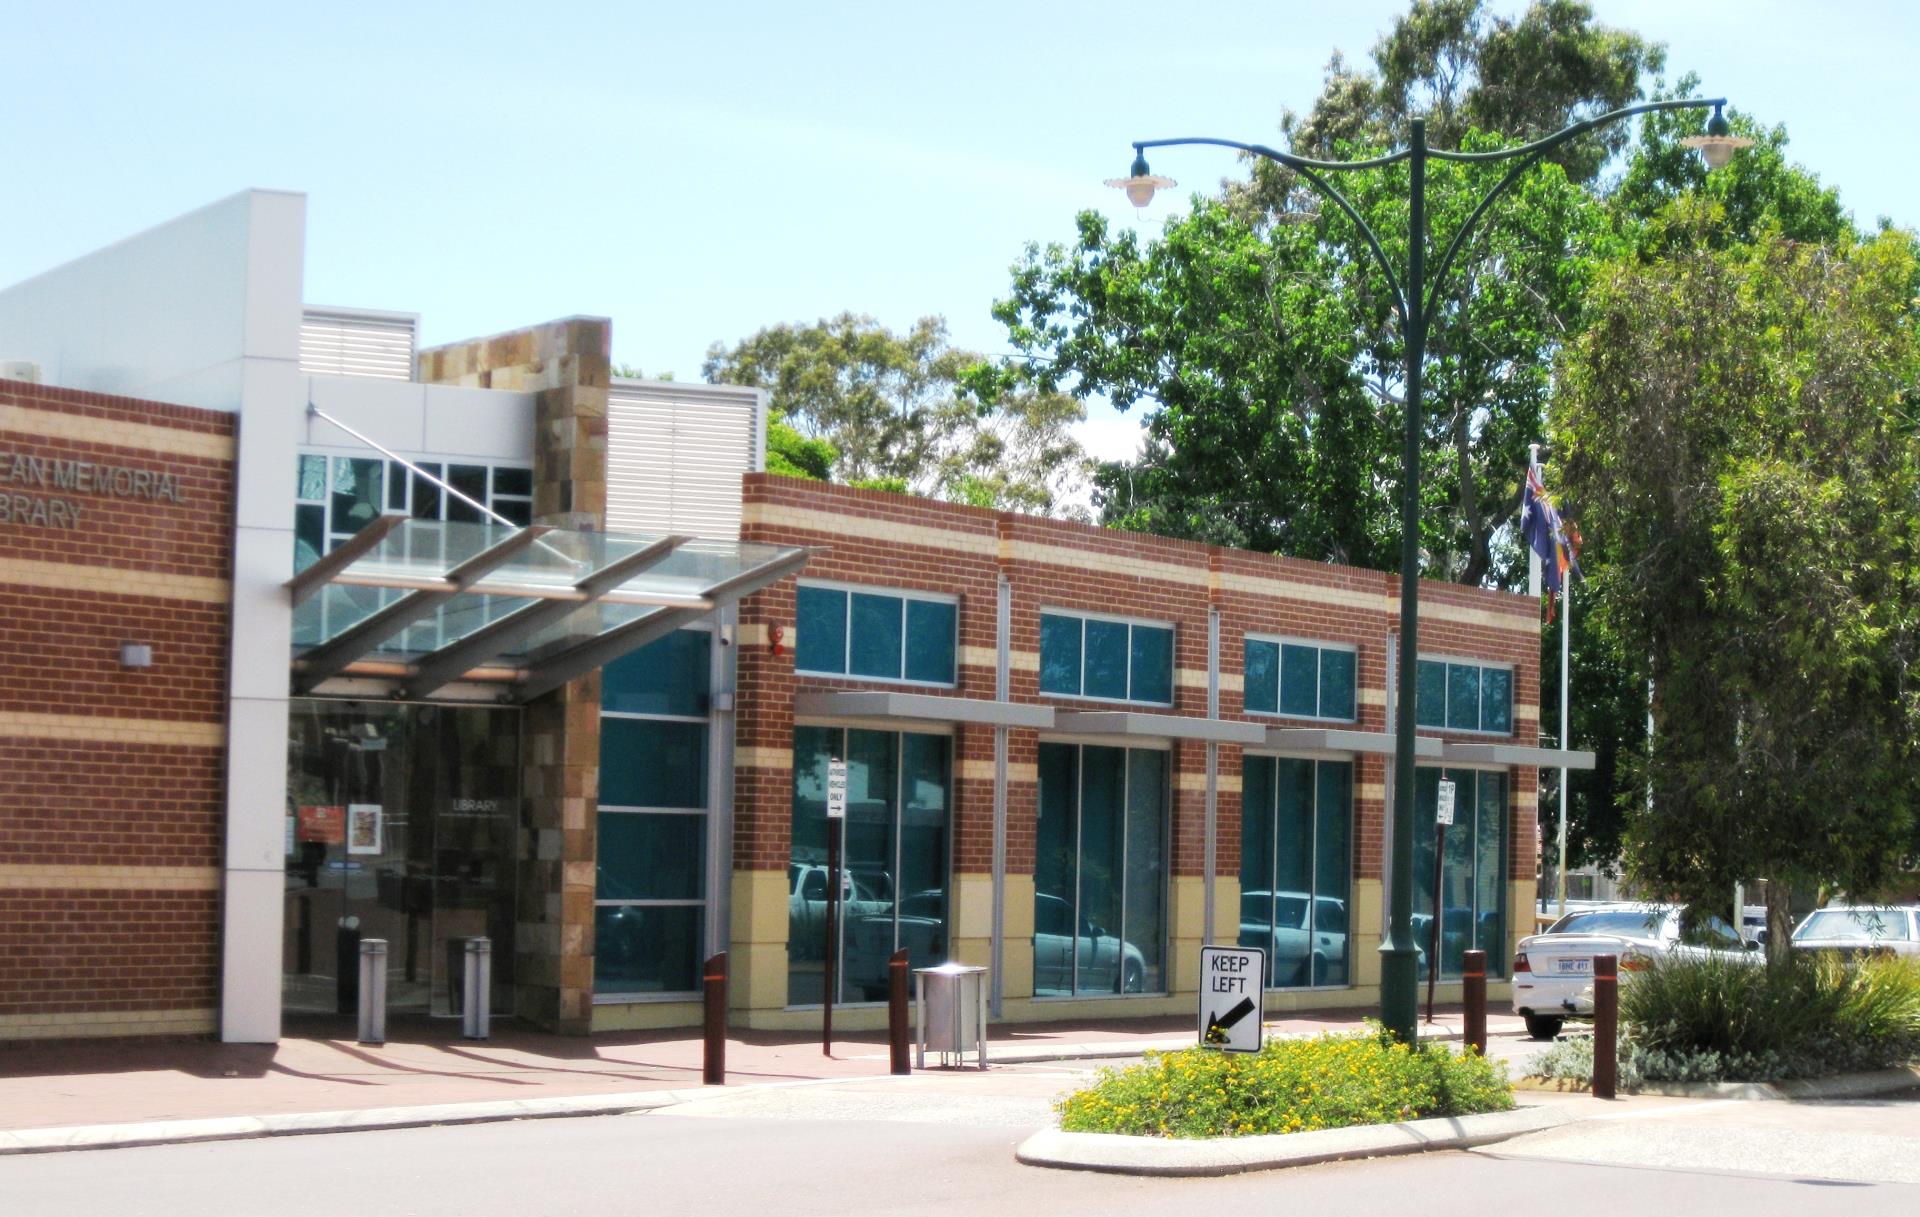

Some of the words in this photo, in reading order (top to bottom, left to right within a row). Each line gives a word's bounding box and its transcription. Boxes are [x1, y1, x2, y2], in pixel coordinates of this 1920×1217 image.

[54, 458, 188, 503] MEMORIAL
[453, 799, 498, 812] LIBRARY
[829, 792, 843, 801] ONLY
[1211, 955, 1250, 973] KEEP
[1212, 976, 1247, 994] LEFT
